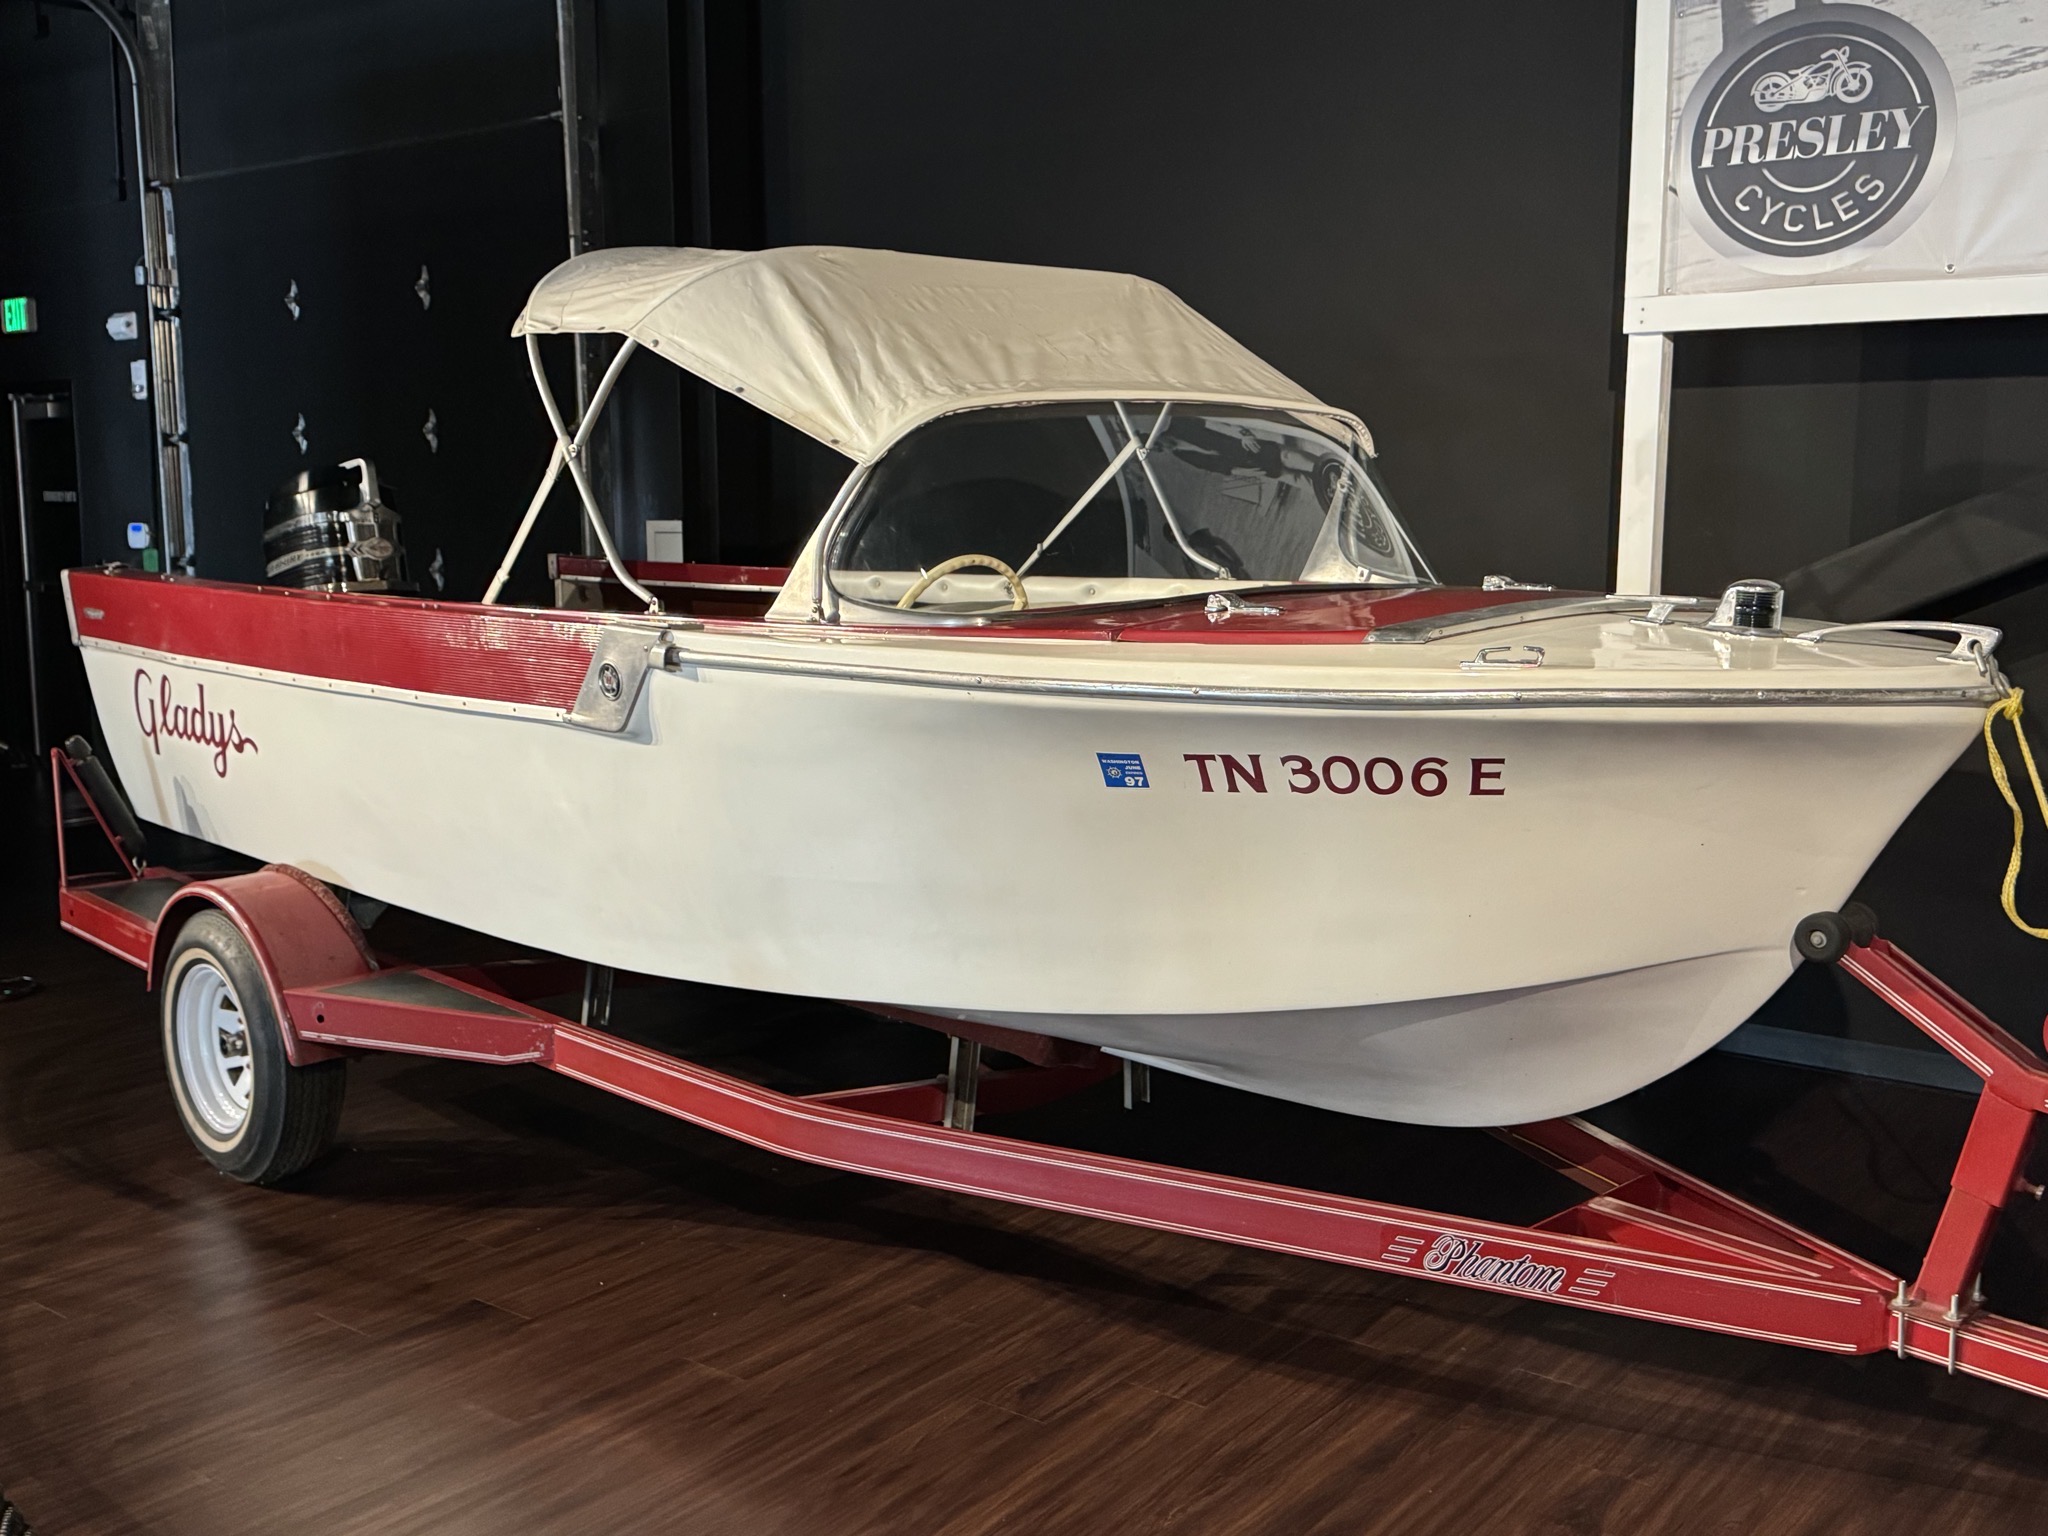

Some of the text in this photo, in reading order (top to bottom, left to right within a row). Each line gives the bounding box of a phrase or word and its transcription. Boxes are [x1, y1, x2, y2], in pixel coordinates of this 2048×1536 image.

[1697, 105, 1929, 169] PRESLEY
[1734, 173, 1886, 233] CYCLES
[4, 297, 27, 332] EXIT
[134, 668, 259, 778] Gladys
[1124, 776, 1144, 786] 97
[1183, 754, 1506, 797] TN 3006 E
[1423, 1233, 1567, 1294] Phantom
